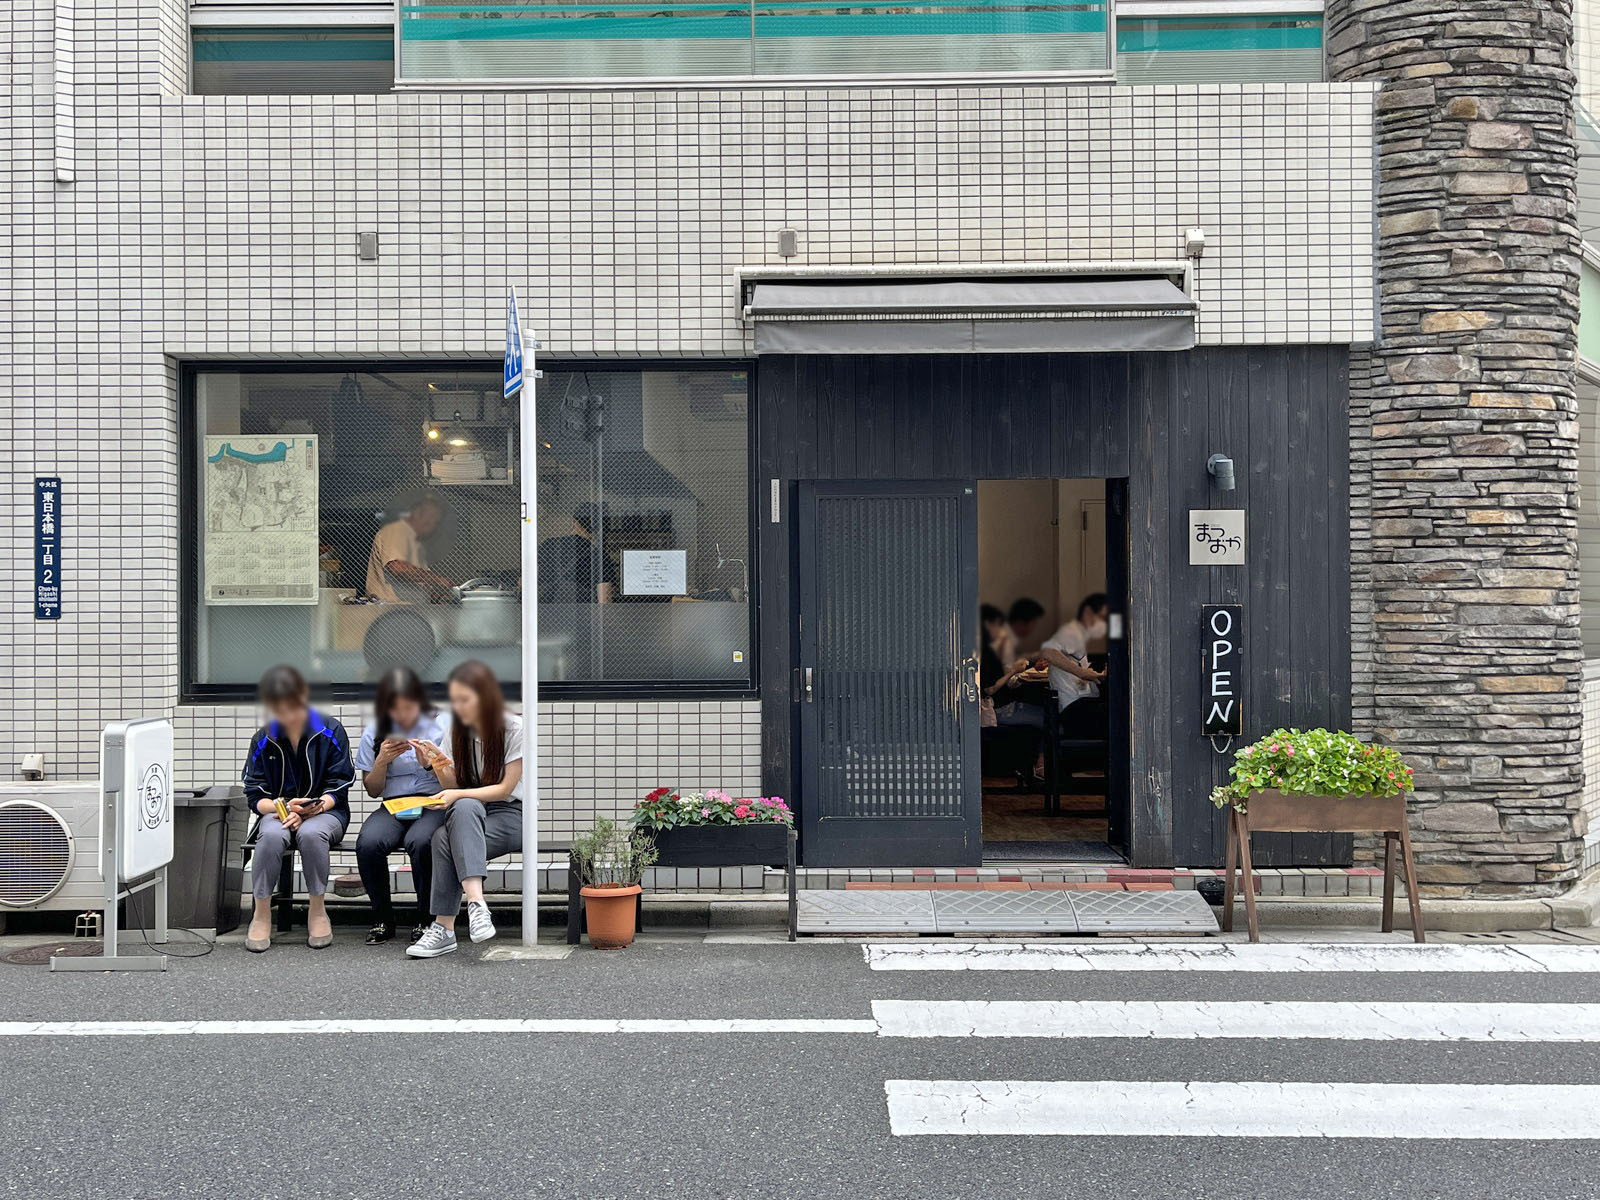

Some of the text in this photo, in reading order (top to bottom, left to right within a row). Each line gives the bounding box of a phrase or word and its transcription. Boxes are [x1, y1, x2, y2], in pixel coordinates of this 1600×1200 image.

[43, 569, 53, 584] 2
[45, 607, 51, 616] 2
[1205, 609, 1235, 725] OPEN
